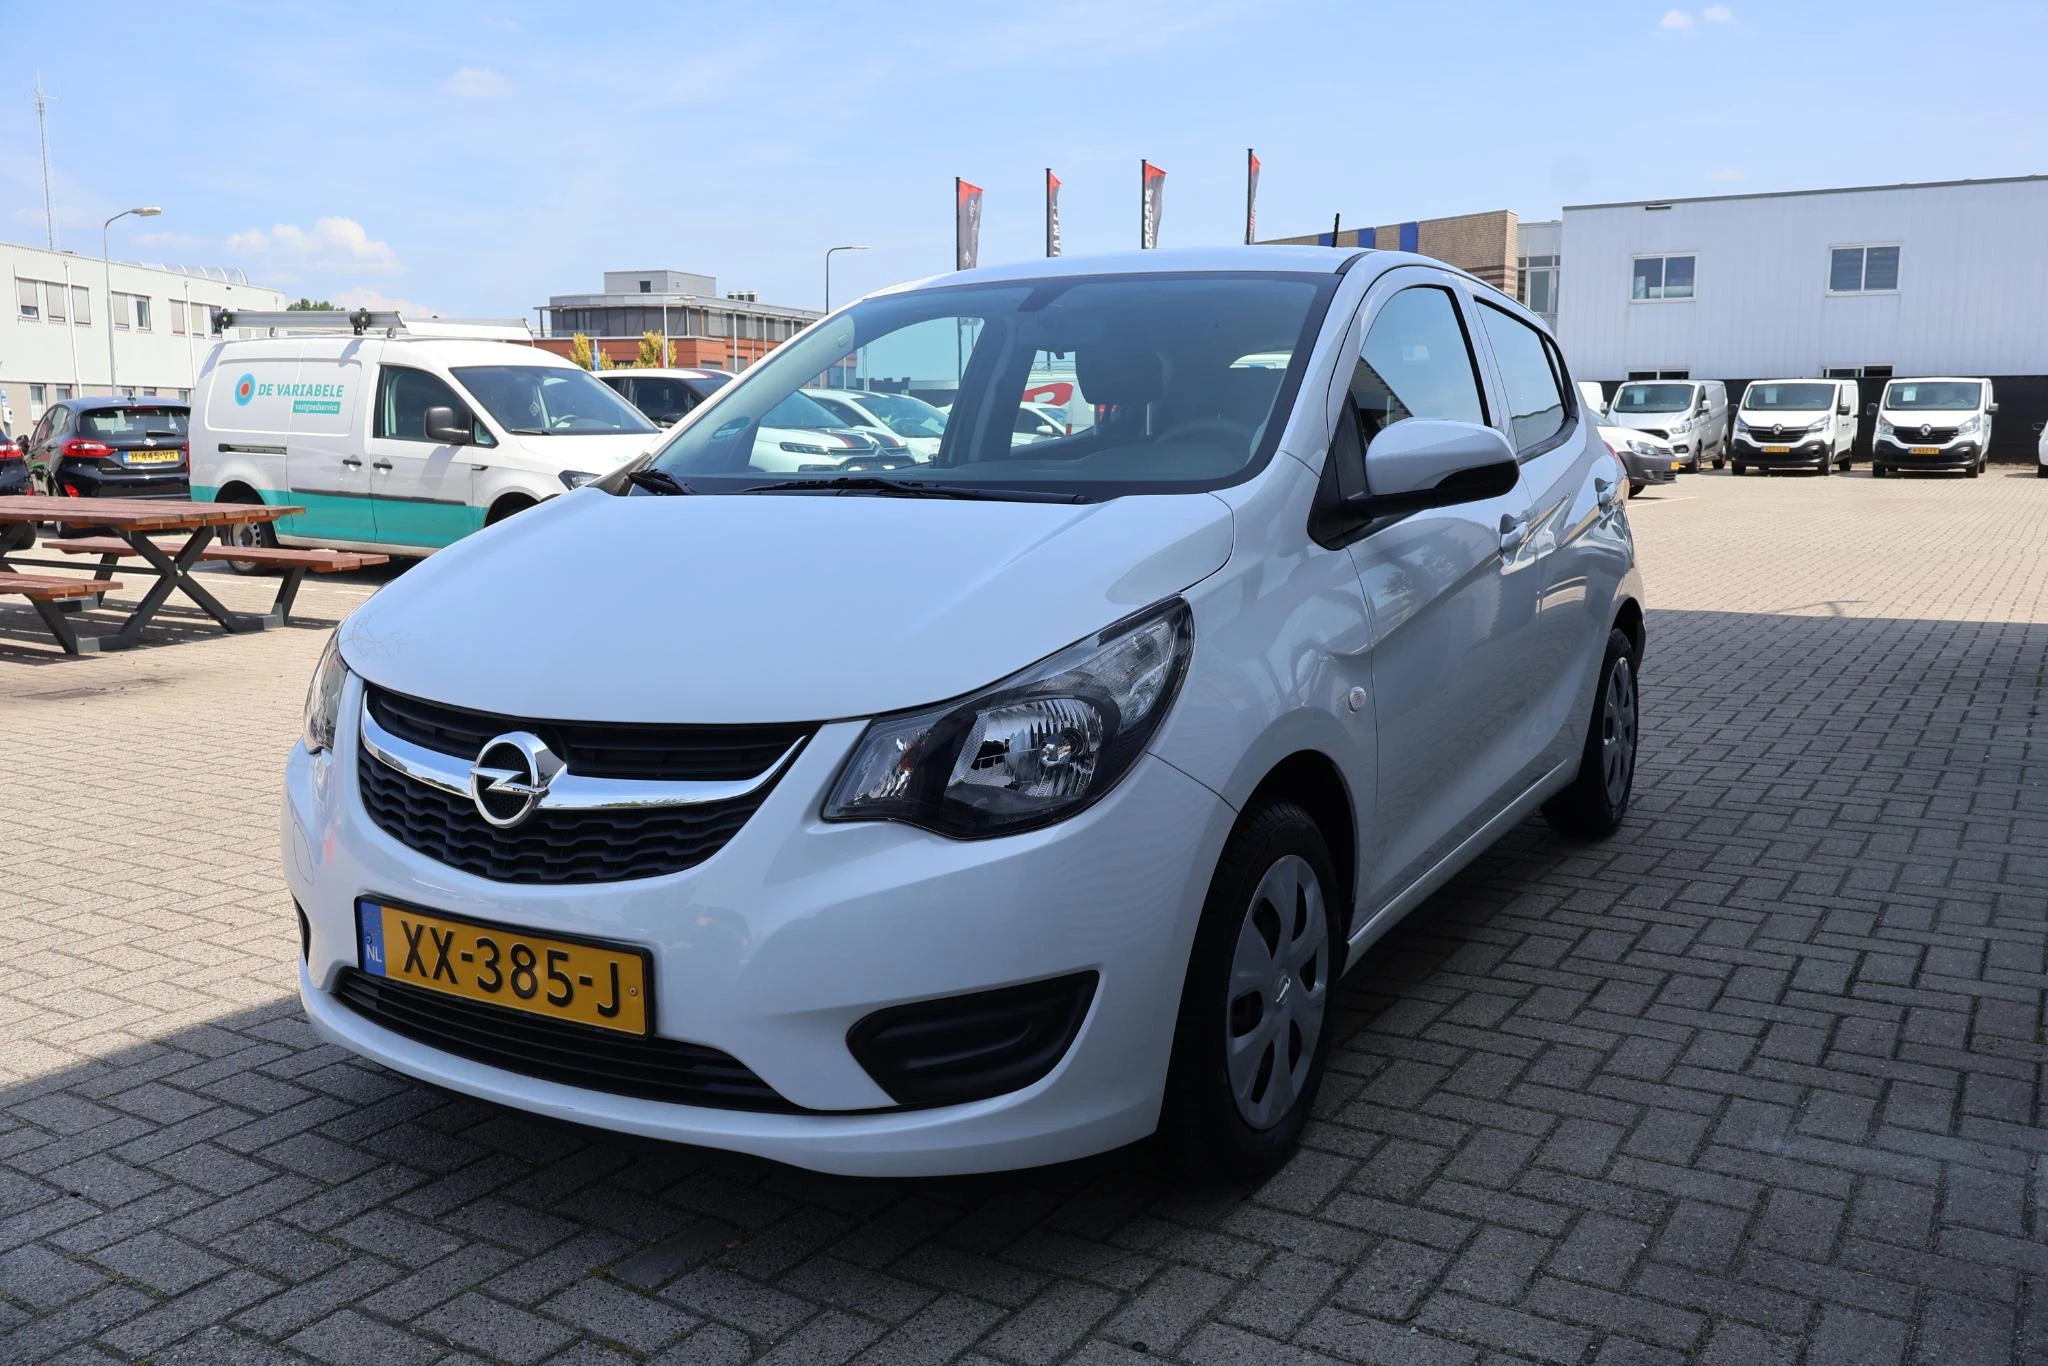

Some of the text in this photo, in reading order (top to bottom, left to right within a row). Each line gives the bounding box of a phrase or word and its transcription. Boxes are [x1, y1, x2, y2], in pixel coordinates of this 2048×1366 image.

[258, 383, 344, 397] DE VARIABELE
[130, 451, 176, 461] H-445-VR
[366, 944, 382, 963] NL
[400, 919, 620, 1018] XX-385-J
